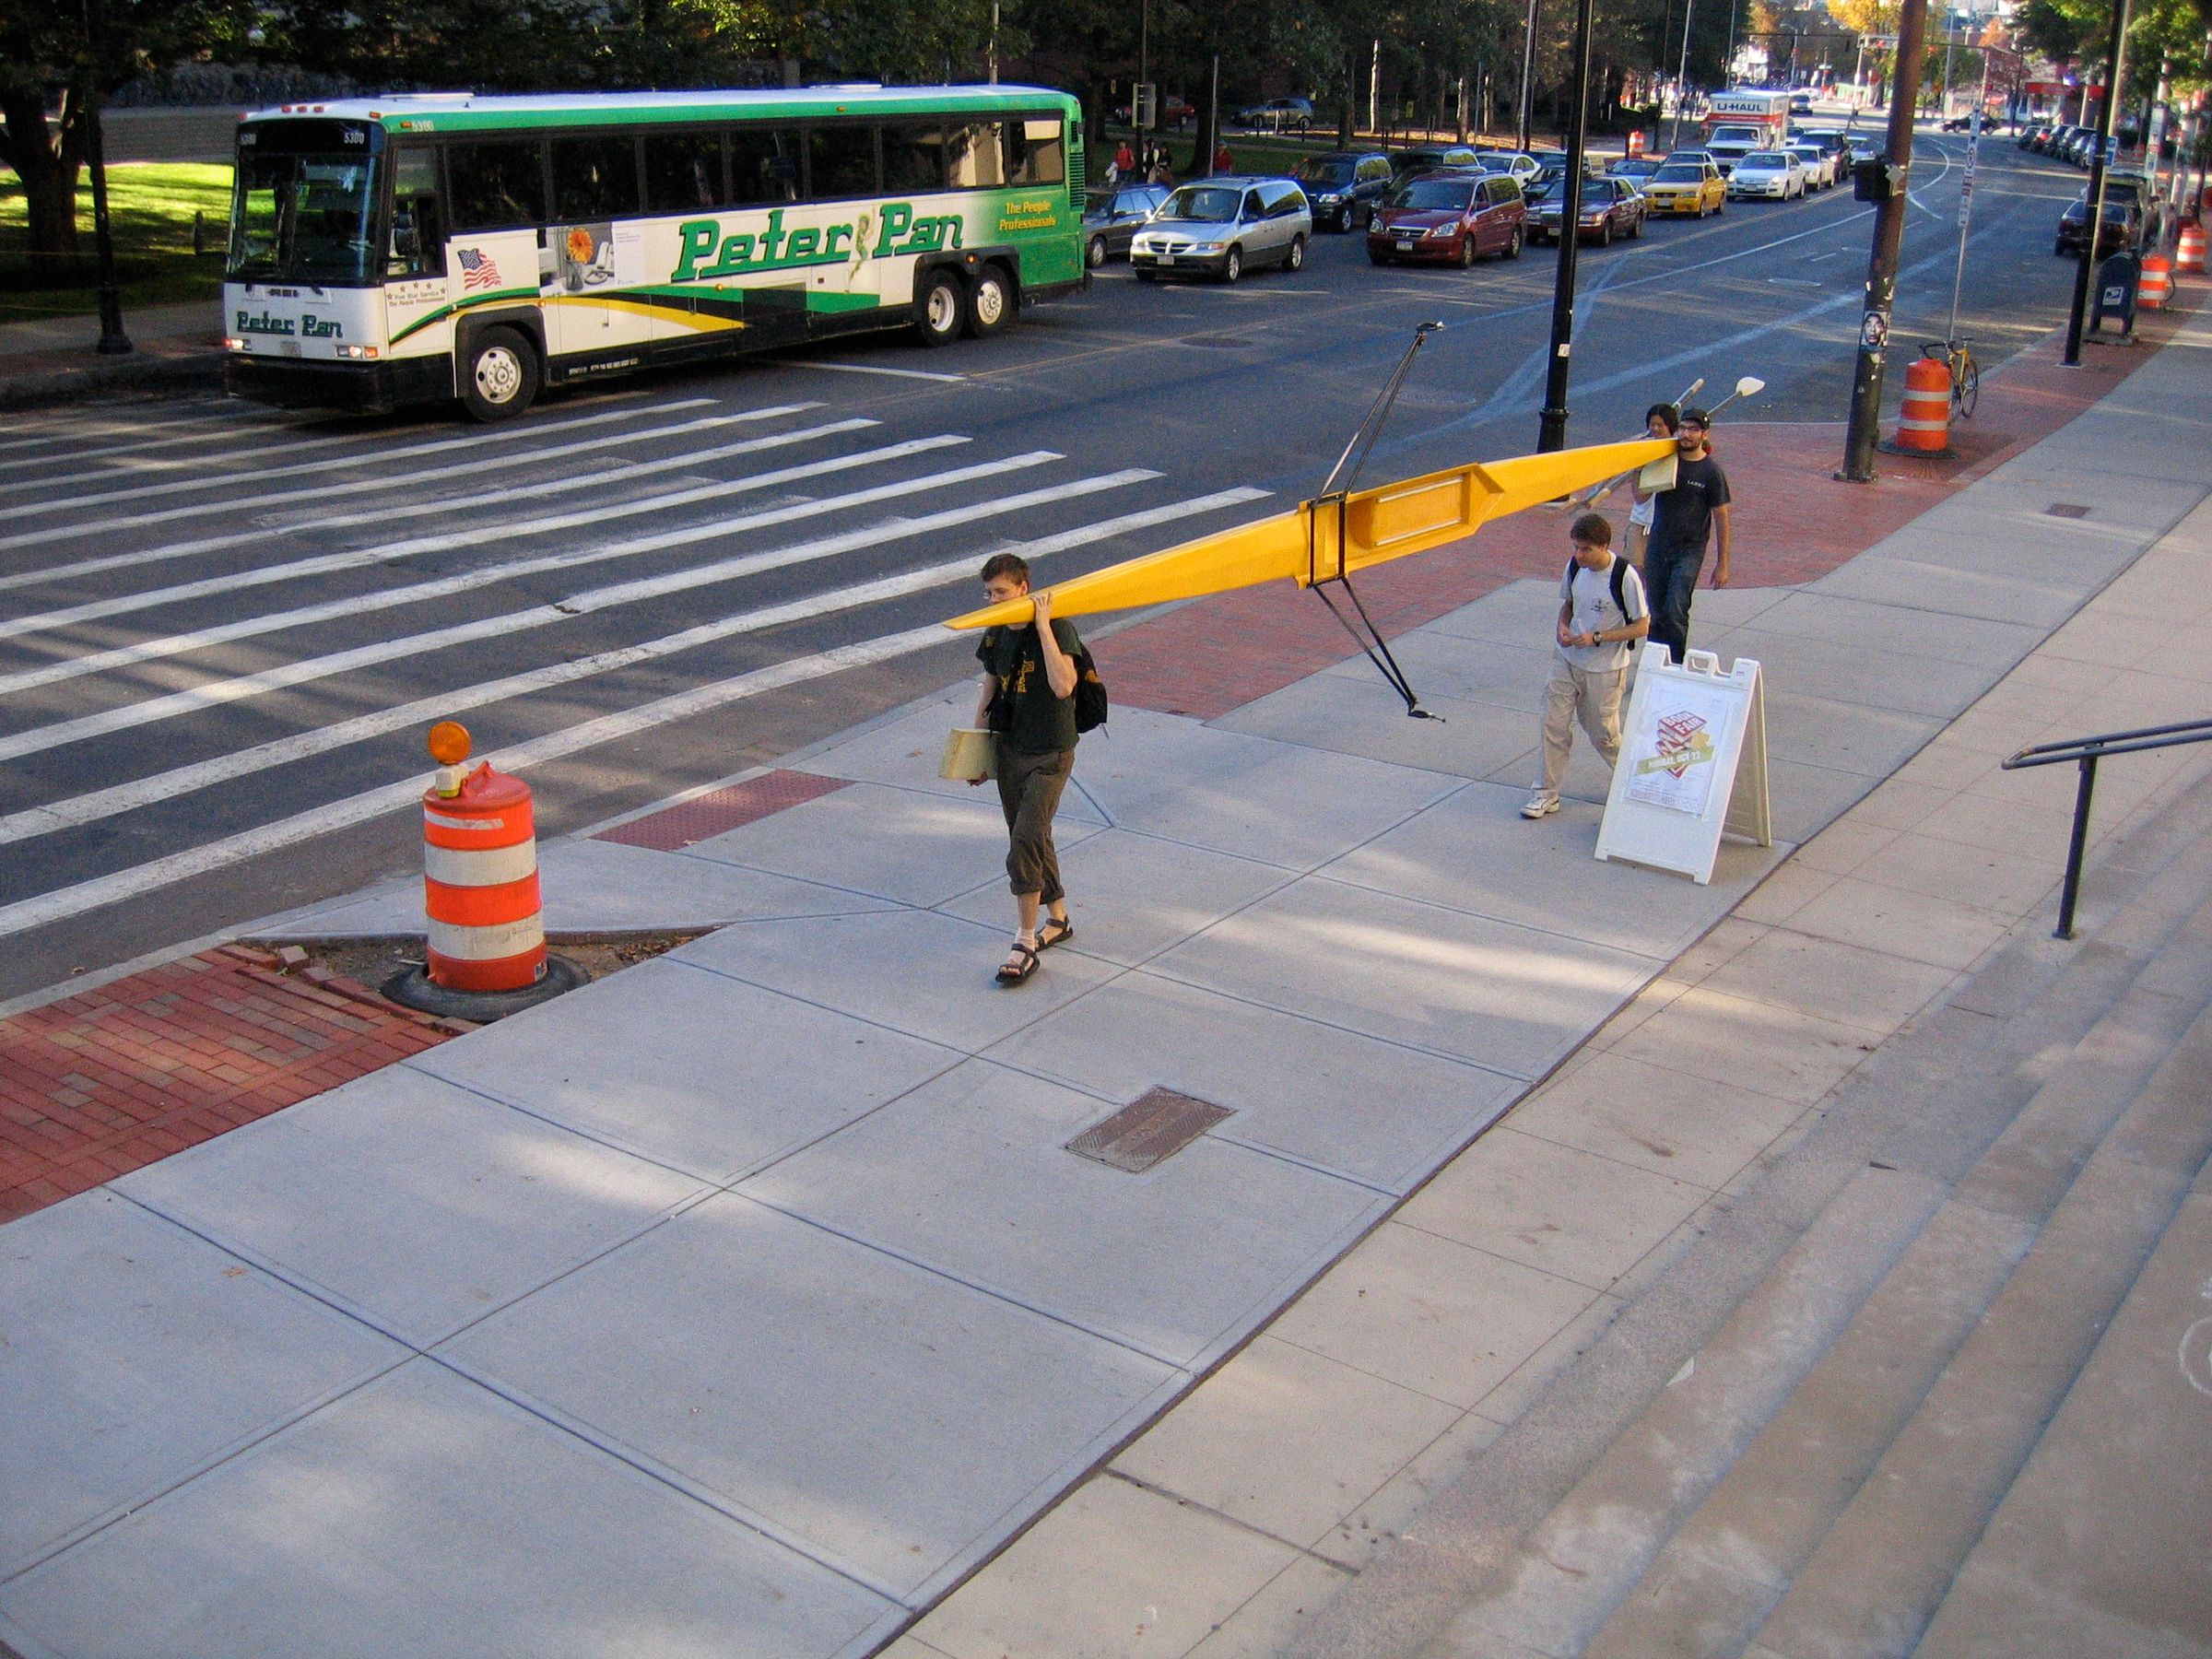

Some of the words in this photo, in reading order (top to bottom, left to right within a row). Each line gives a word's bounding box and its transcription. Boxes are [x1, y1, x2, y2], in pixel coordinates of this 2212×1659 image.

[1717, 103, 1762, 112] U-HAUL
[344, 133, 365, 145] 5300
[1006, 203, 1021, 215] The
[1023, 200, 1051, 215] People
[999, 215, 1056, 231] Professionals
[671, 209, 853, 284] Peter
[872, 202, 964, 259] Pan
[237, 310, 295, 335] Peter
[301, 314, 343, 338] Pan
[1662, 712, 1694, 726] BOOK
[1674, 717, 1703, 734] FAIR
